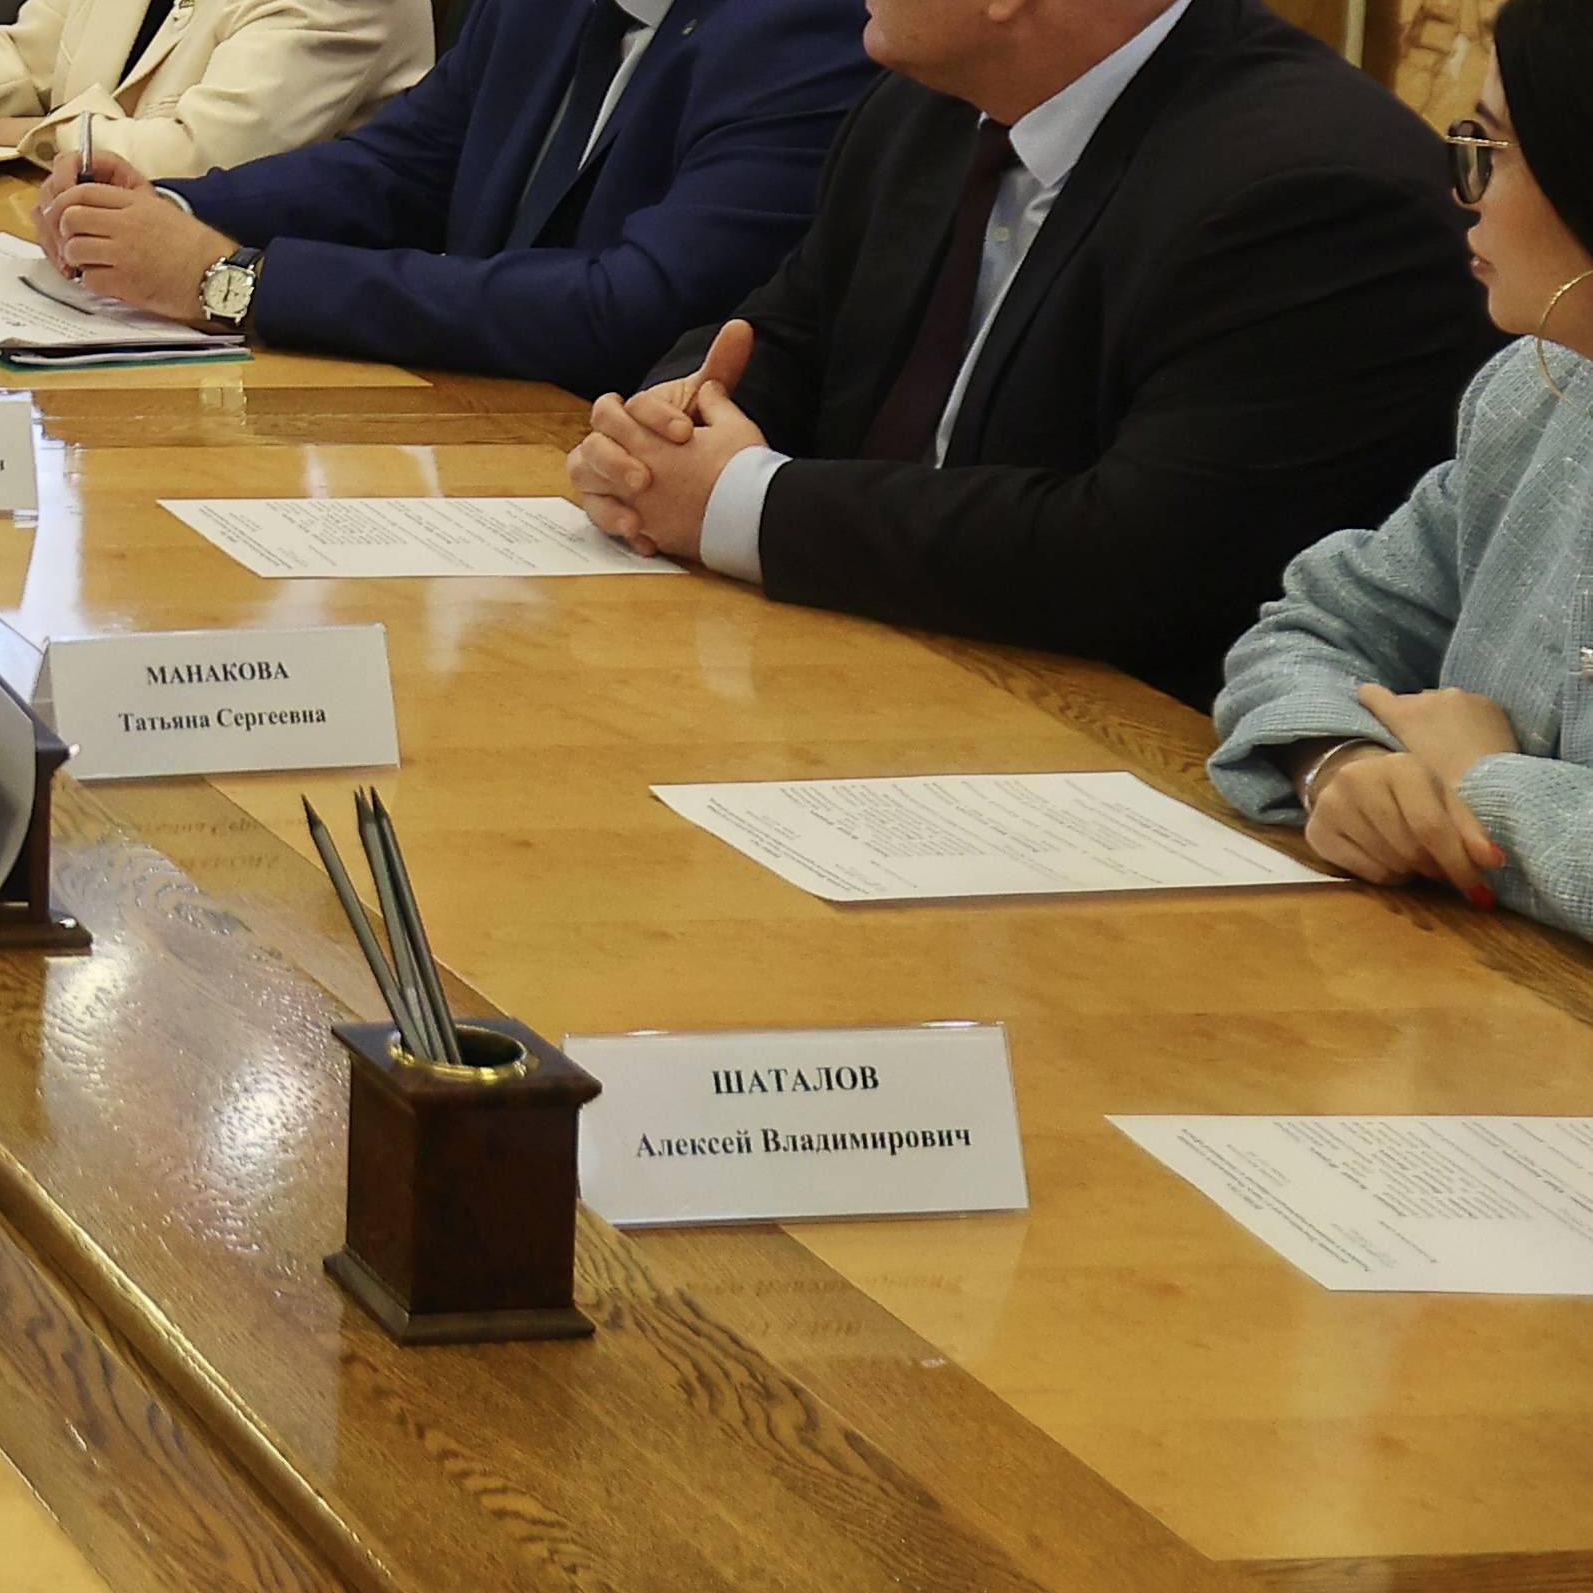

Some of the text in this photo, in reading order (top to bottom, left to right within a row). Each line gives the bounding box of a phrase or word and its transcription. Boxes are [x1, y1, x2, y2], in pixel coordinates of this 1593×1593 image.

[146, 661, 289, 685] МАНАКОВА
[118, 708, 326, 732] Татьяна Сергеевна
[712, 1066, 879, 1095] ШАТАЛОВ
[637, 1128, 971, 1157] Алексей Владимирович
